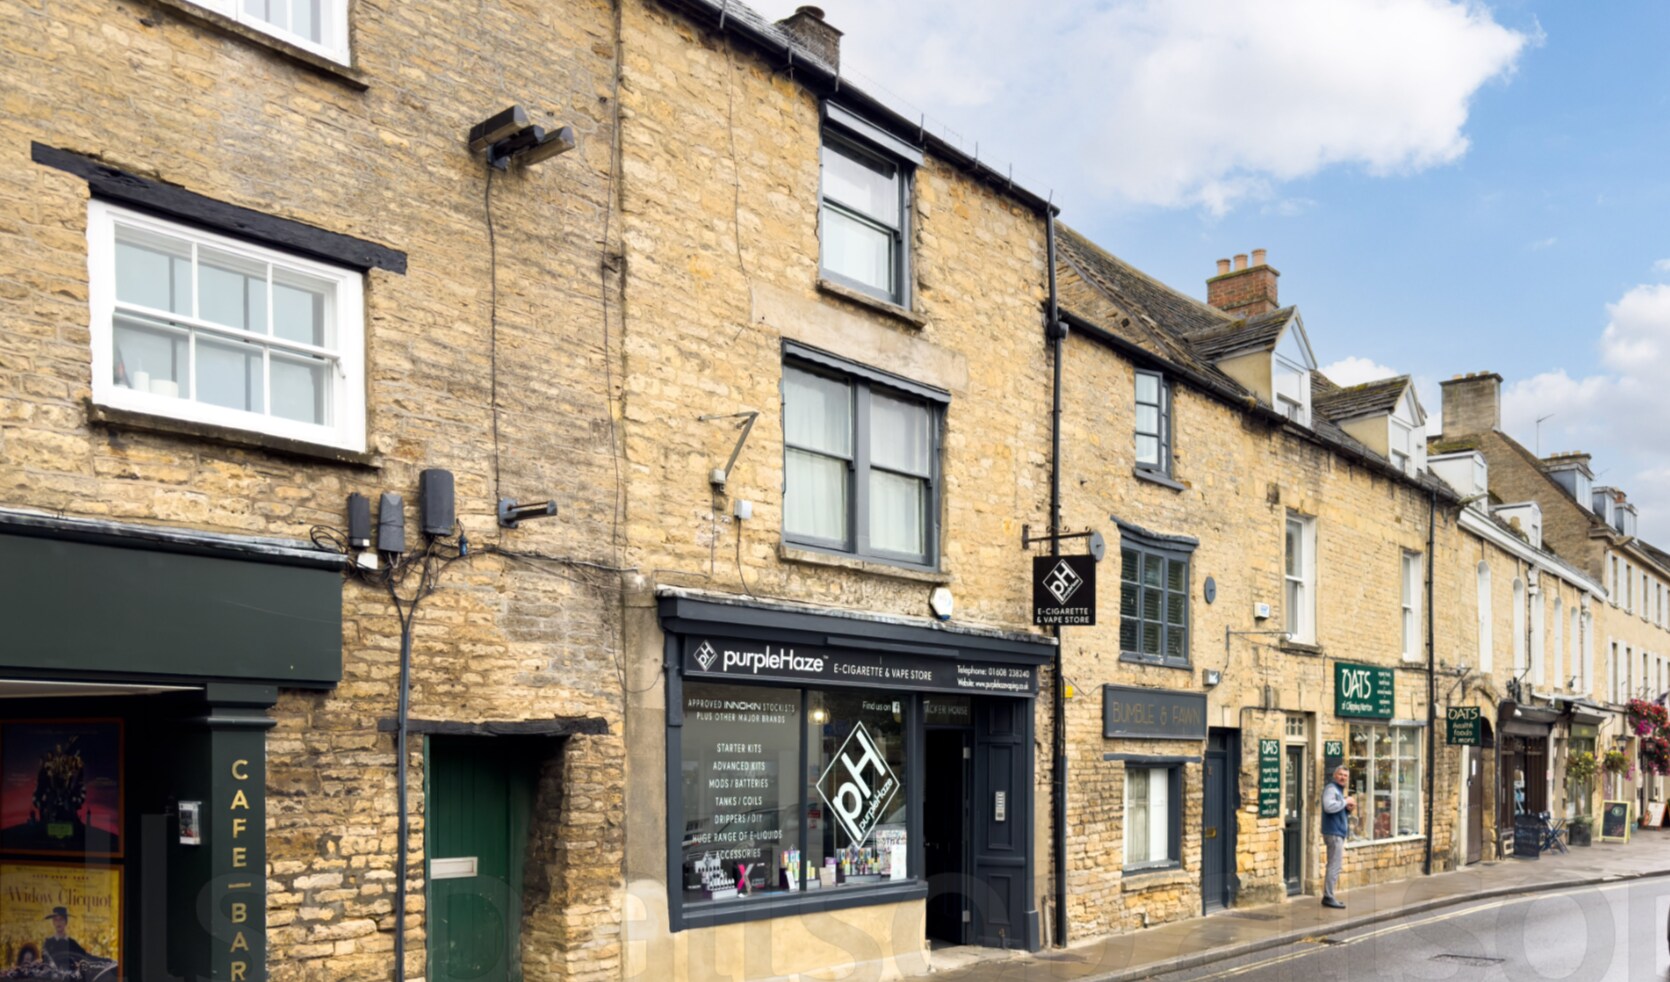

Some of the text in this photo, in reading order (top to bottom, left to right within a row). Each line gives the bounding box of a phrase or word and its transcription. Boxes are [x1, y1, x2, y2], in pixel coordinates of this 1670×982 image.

[1037, 607, 1089, 615] E-CIGARETTE
[833, 663, 883, 677] E-CIGARETTE
[885, 668, 890, 678] &
[892, 669, 909, 679] VAPE
[910, 670, 932, 681] STORE
[957, 665, 987, 676] Telephone:
[988, 667, 1007, 677] 01608
[1342, 669, 1371, 699] OATS
[688, 698, 722, 709] APPROVED
[762, 702, 796, 713] STOCKISTS
[862, 701, 874, 710] Find
[876, 703, 883, 711] us
[696, 711, 785, 724] PLUS OTHER MAJOR BRANDS
[1112, 701, 1200, 725] BUMBLE & FAWN
[1448, 708, 1478, 720] OATS
[717, 743, 762, 753] STARTER KITS
[1262, 741, 1278, 755] OATS
[1327, 742, 1340, 756] OATS
[713, 761, 766, 771] ADVANCED KITS
[709, 779, 729, 788] MODS
[734, 779, 768, 788] BATTERIES
[715, 796, 737, 806] TANKS
[743, 796, 762, 806] COILS
[714, 814, 746, 824] DRIPPERS
[692, 830, 783, 843] HUGE RANGE OF E-LIQUIDS
[8, 886, 112, 912] Widow Clicquot
